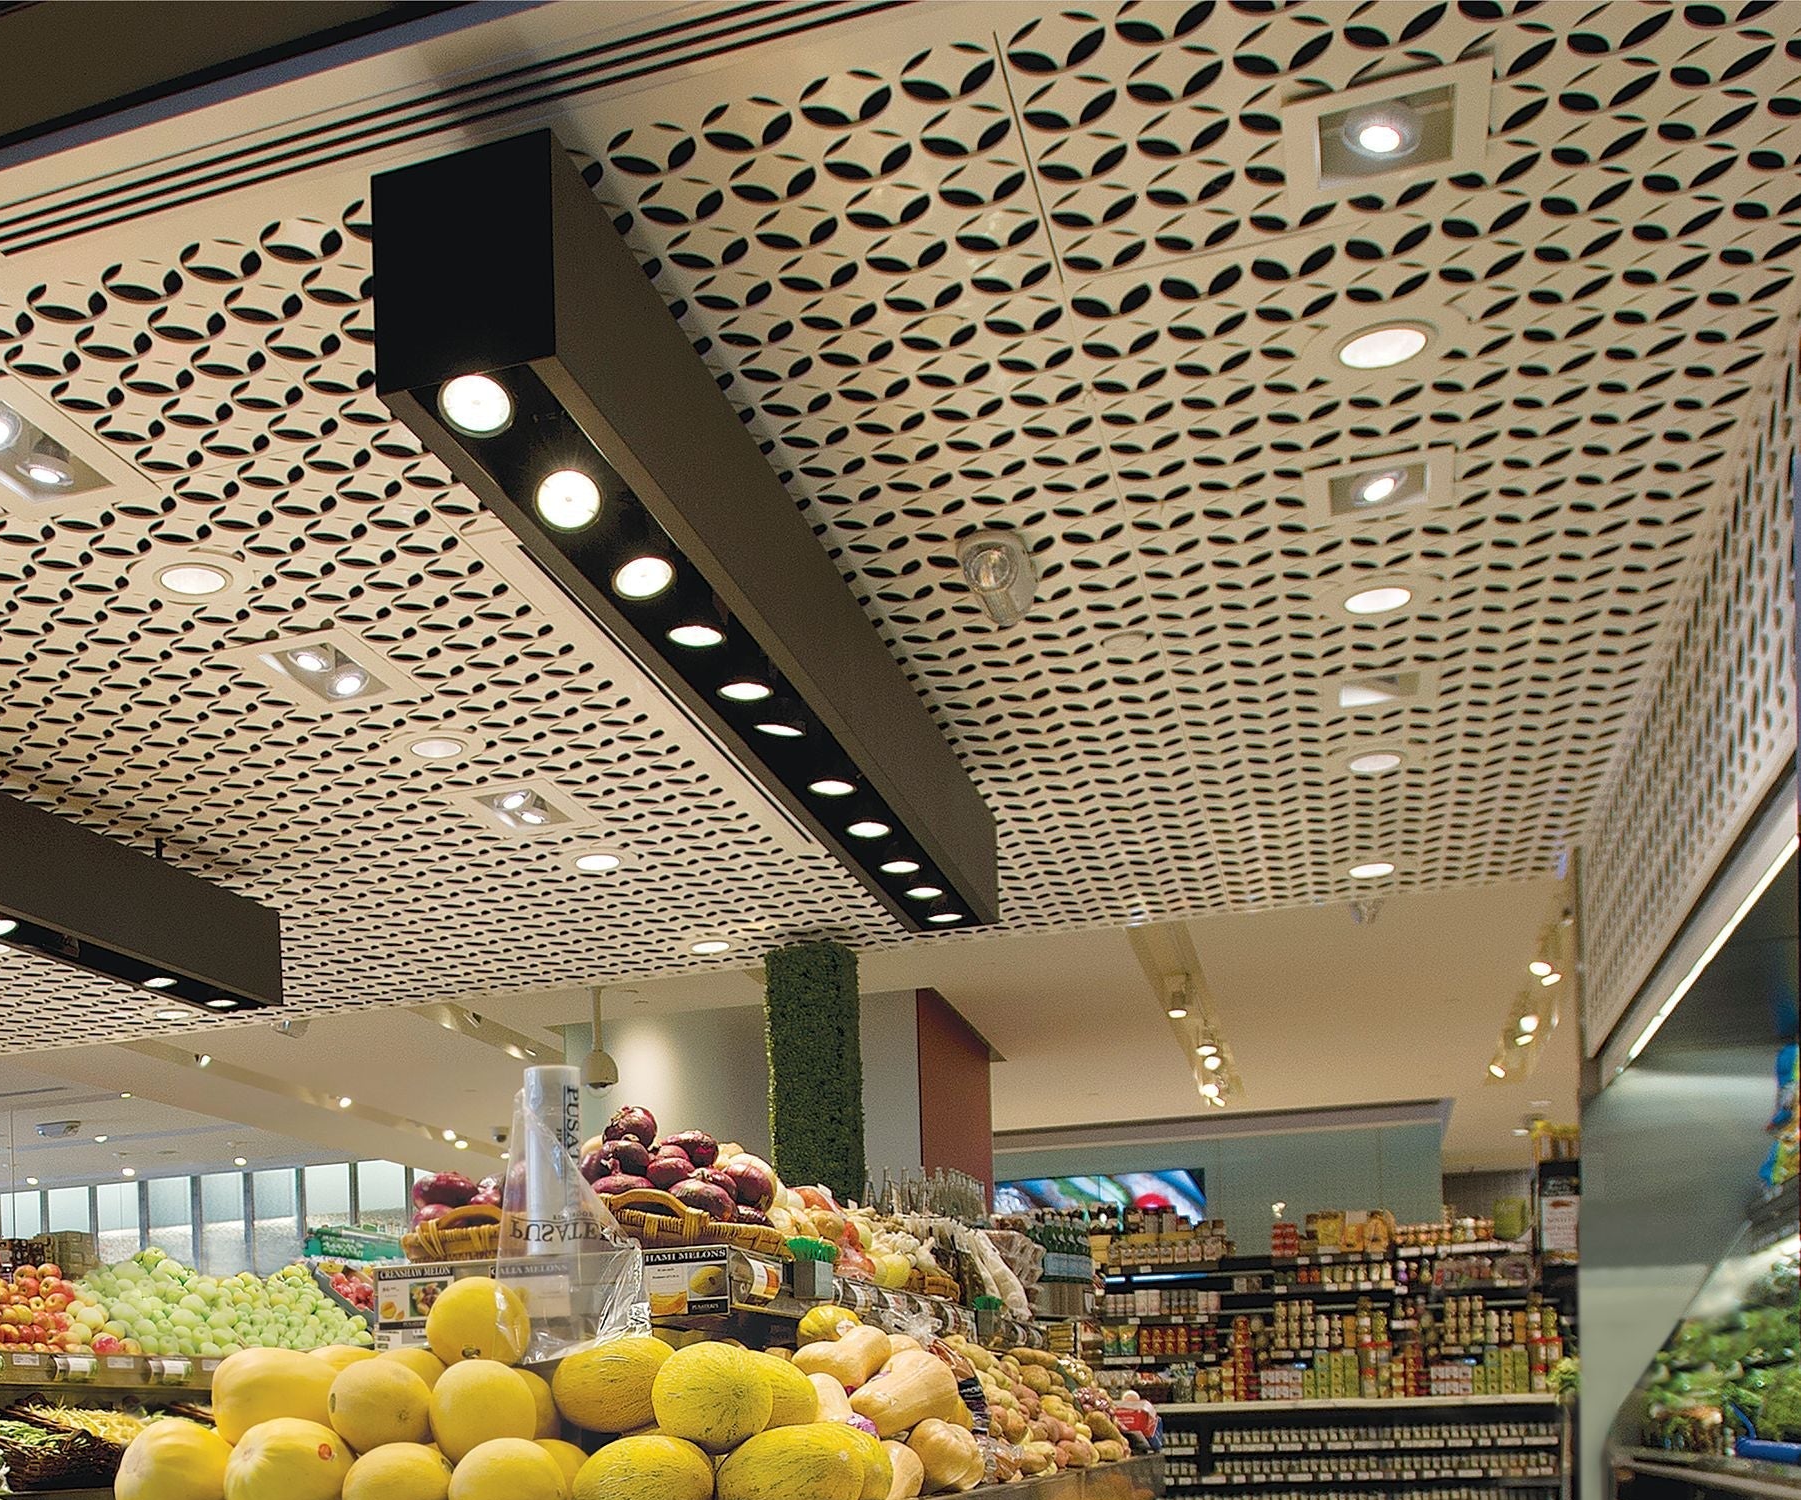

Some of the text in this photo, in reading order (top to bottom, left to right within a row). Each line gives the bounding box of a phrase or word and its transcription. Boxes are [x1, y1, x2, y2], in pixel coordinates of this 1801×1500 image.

[645, 1249, 726, 1263] HAMI MELONS
[380, 1265, 451, 1280] CRENSHAW MELON
